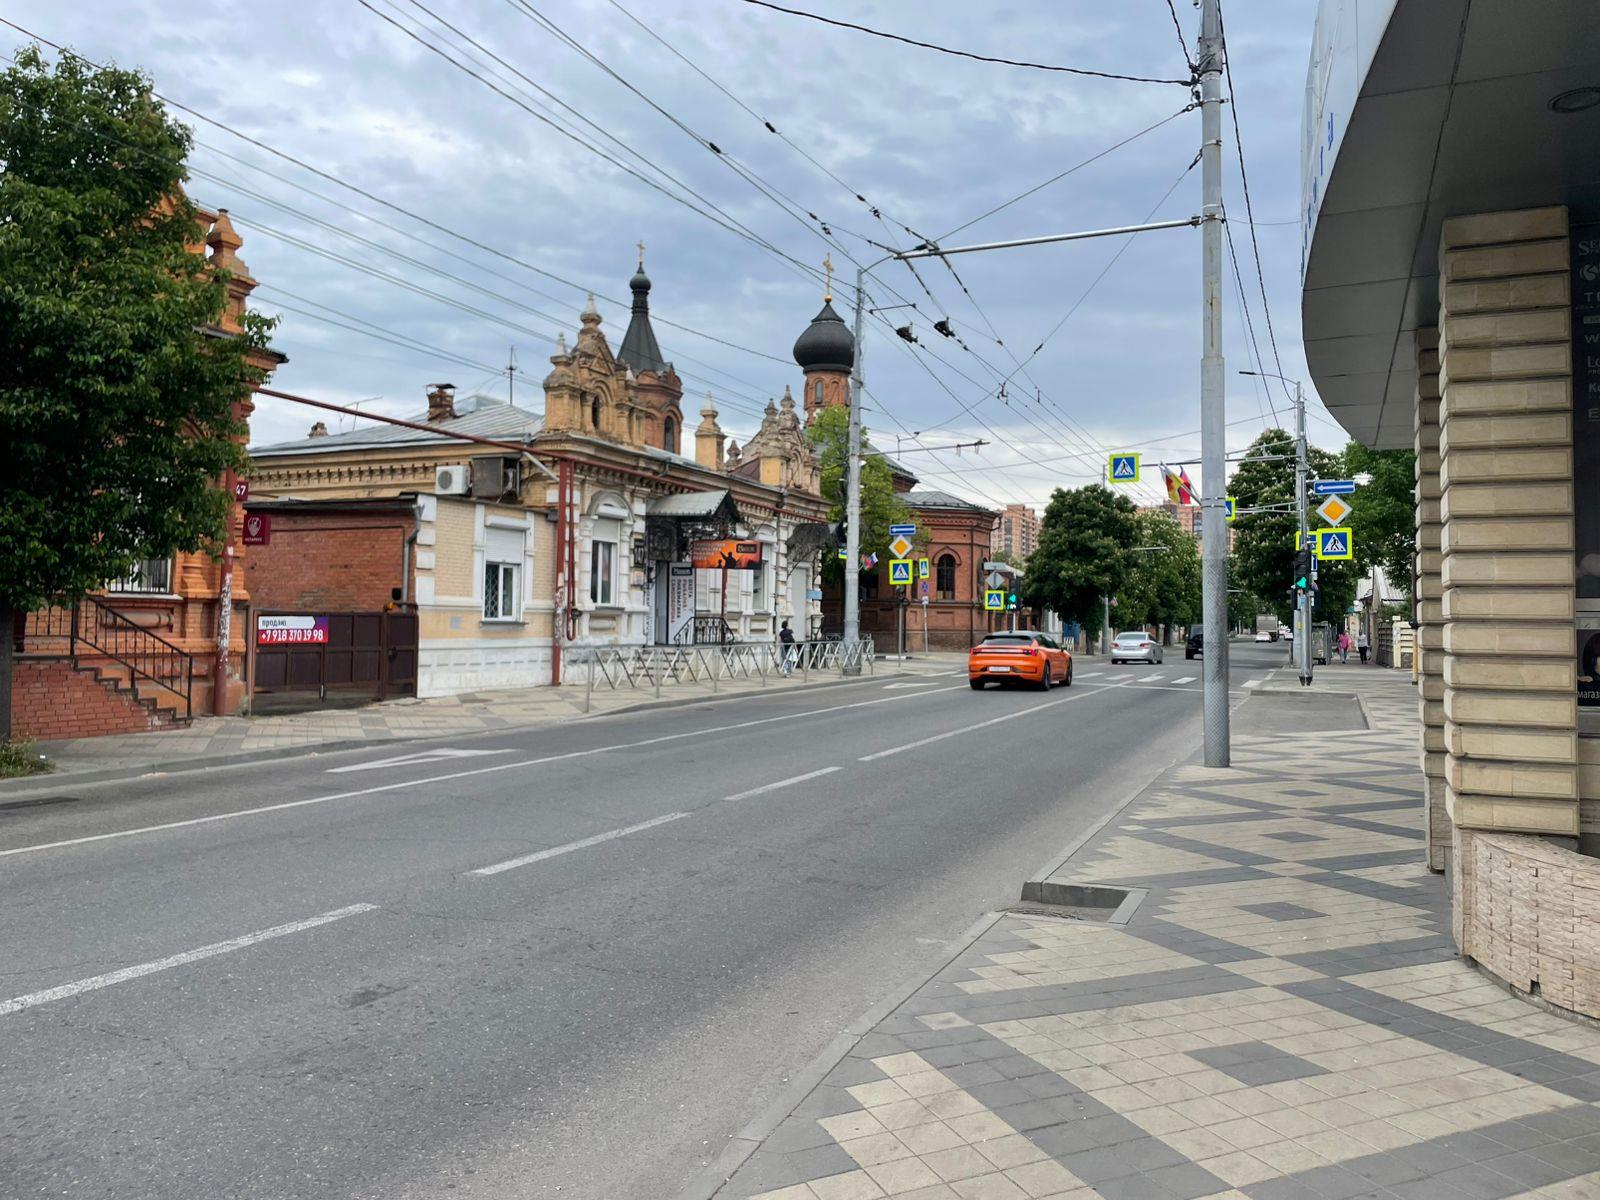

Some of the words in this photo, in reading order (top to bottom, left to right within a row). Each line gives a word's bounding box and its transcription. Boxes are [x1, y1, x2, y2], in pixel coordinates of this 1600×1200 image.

[261, 618, 287, 628] продаю
[261, 629, 271, 642] +7
[272, 629, 287, 642] 918
[288, 629, 302, 642] 370
[303, 629, 312, 641] 19
[313, 629, 324, 641] 98
